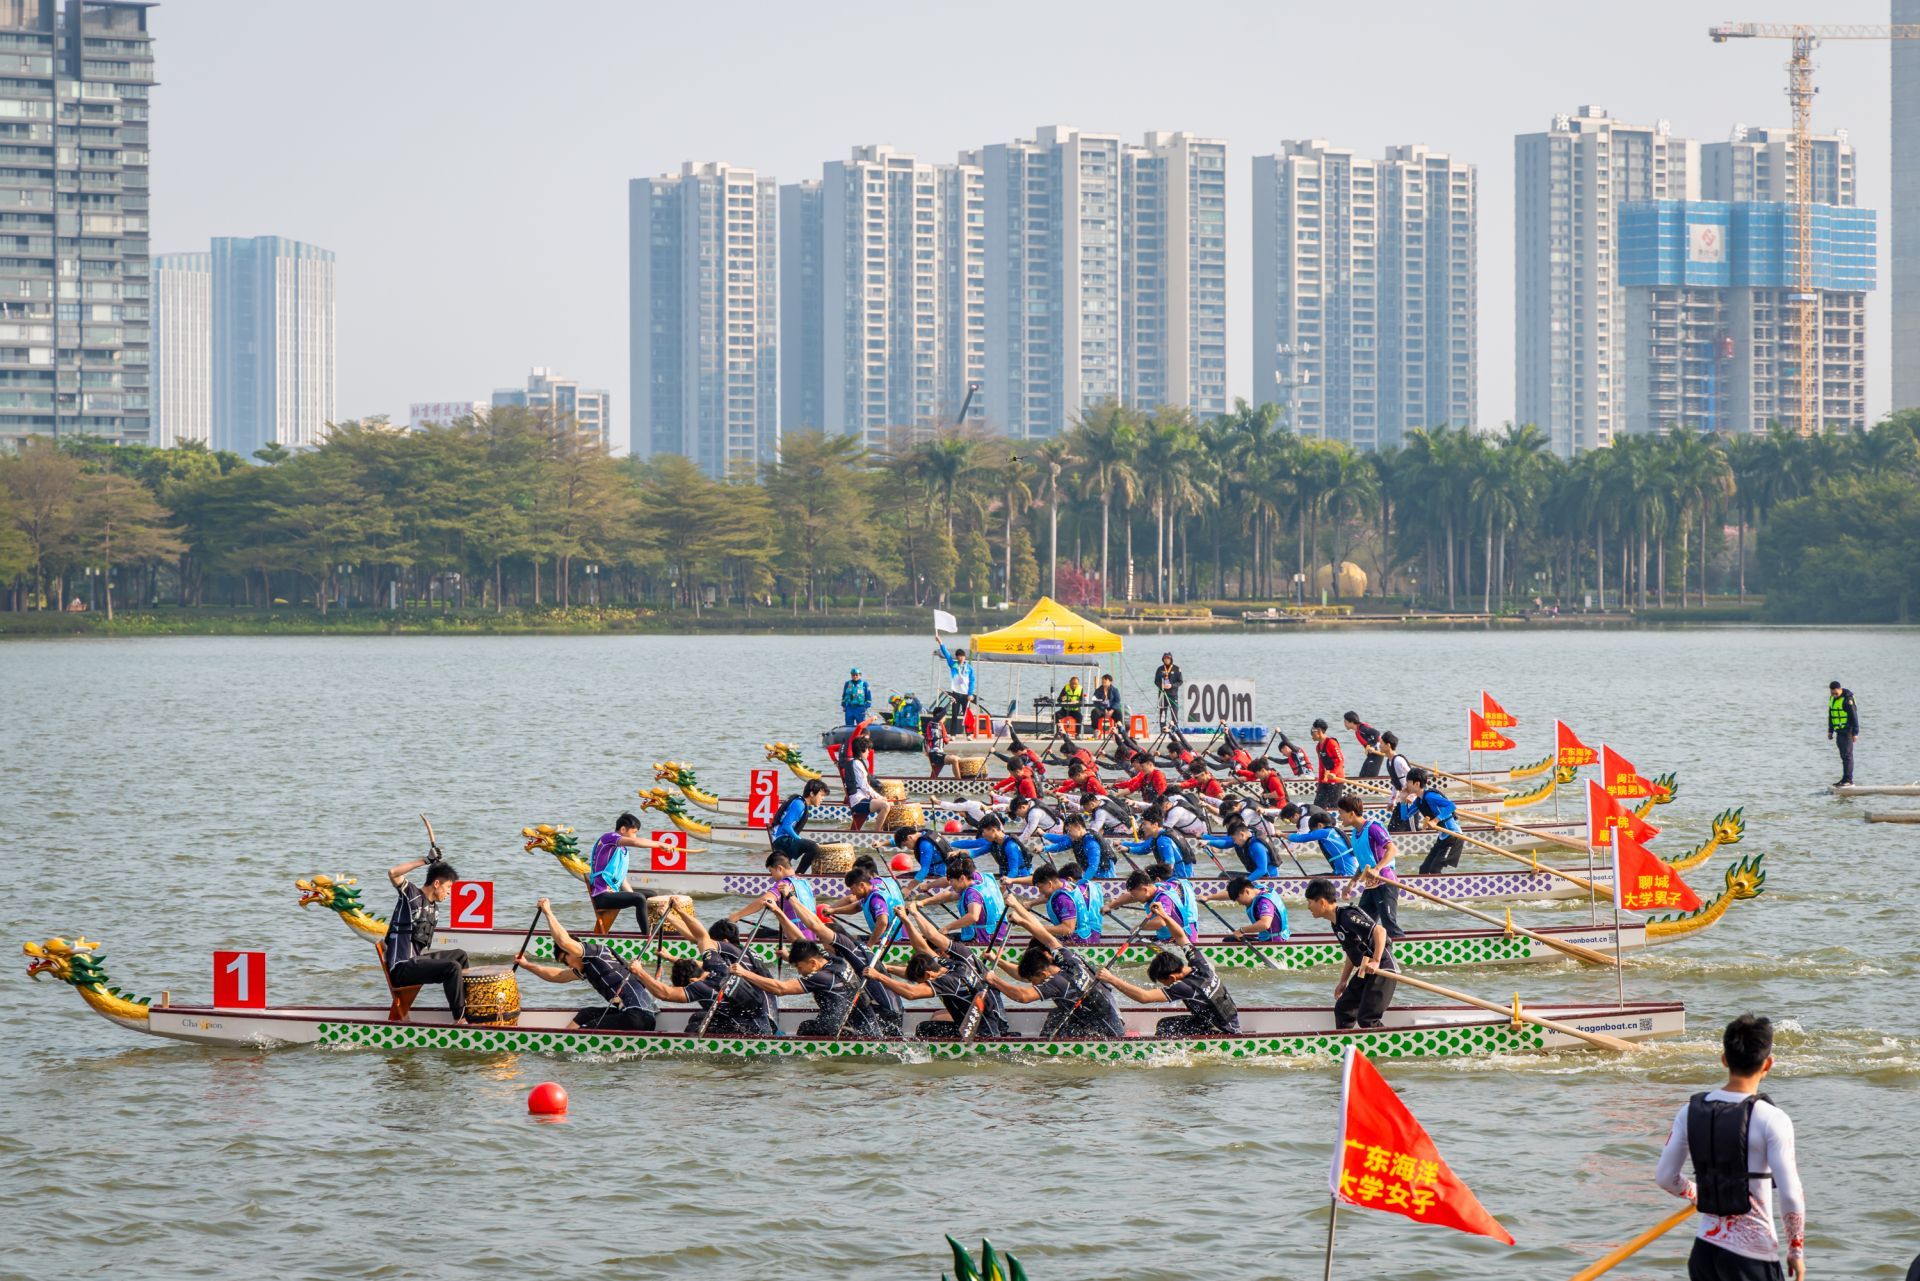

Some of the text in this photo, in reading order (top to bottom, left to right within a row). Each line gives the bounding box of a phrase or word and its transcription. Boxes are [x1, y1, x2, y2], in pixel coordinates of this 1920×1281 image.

[1188, 683, 1252, 723] 200m
[755, 770, 774, 796] 5
[752, 795, 774, 825] 4
[657, 832, 682, 867] 3
[1624, 890, 1684, 907] 大学男子
[1638, 874, 1671, 890] 聊城
[458, 883, 486, 923] 2
[226, 953, 249, 1001] 1
[1344, 1139, 1440, 1186] 广东海洋
[1339, 1168, 1437, 1216] 大学女子
